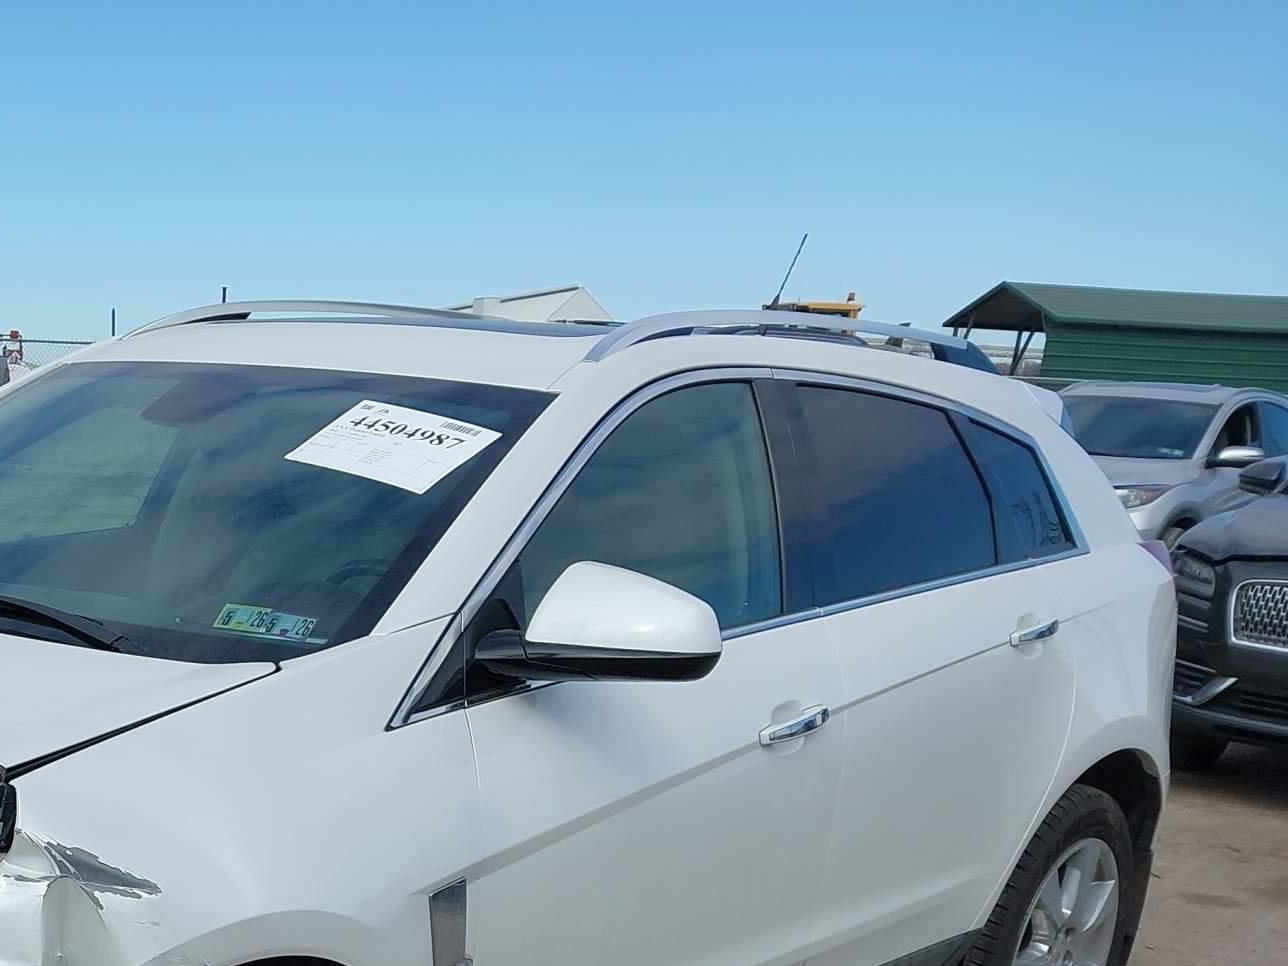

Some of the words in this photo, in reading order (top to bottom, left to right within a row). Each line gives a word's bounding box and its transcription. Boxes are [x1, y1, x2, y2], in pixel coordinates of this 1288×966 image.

[348, 415, 466, 449] 44504987
[222, 611, 234, 626] 5
[250, 610, 269, 628] 26
[265, 617, 279, 633] 5
[295, 619, 314, 637] 26
